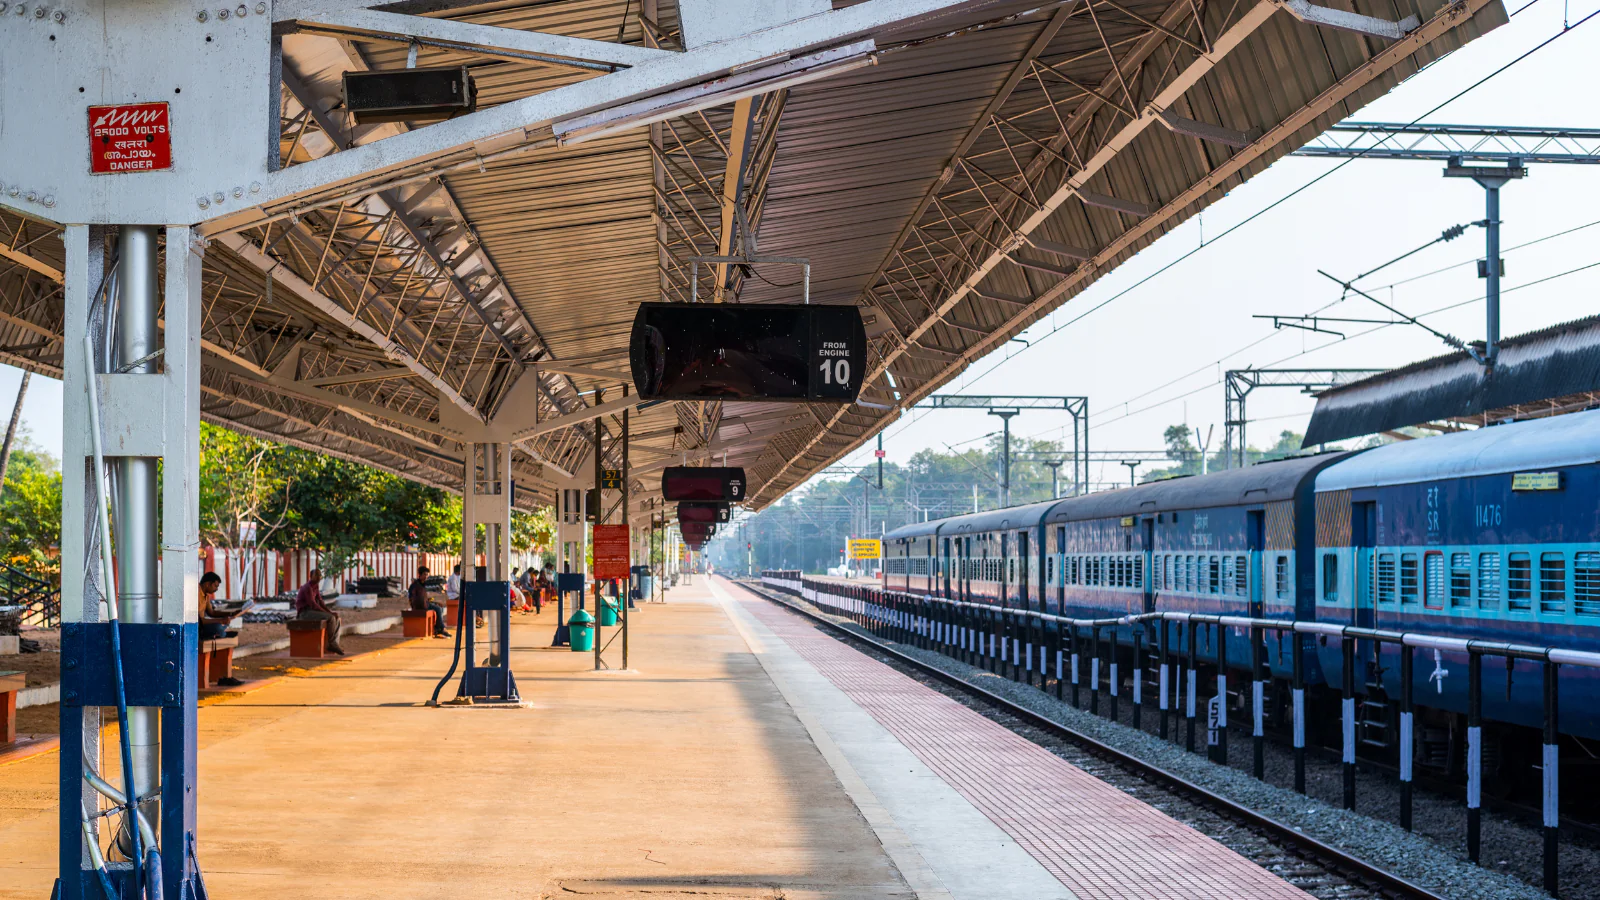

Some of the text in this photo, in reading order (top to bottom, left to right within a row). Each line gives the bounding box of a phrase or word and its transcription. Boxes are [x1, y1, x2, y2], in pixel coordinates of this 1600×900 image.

[94, 125, 166, 137] 25000 VOLTS
[114, 139, 148, 150] खतरा
[103, 149, 156, 160] അപായം
[109, 160, 153, 170] DANGER
[820, 359, 850, 384] 10
[606, 470, 616, 479] 57
[608, 480, 614, 488] 4
[732, 486, 738, 496] 9
[1428, 511, 1440, 531] SR
[1476, 504, 1502, 528] 11476
